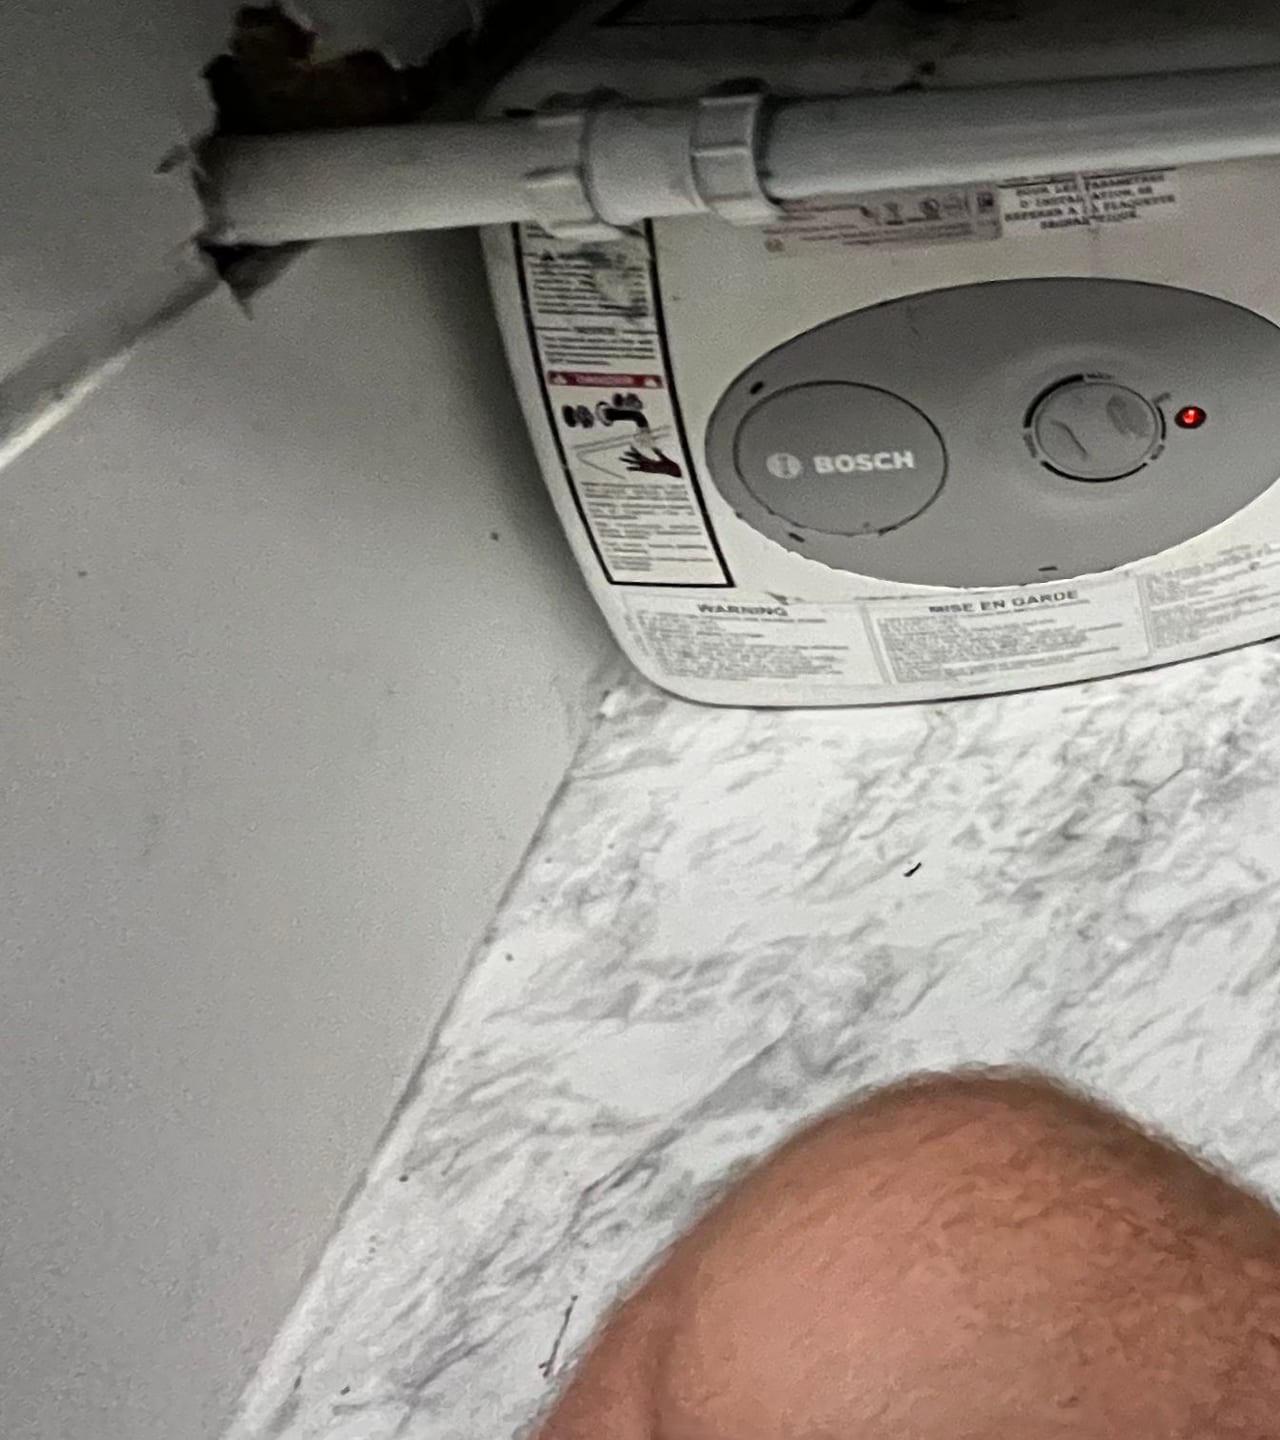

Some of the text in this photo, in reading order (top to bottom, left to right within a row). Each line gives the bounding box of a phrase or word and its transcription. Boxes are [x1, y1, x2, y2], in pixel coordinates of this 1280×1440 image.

[812, 449, 917, 475] BOSCH
[697, 603, 789, 617] WARNING
[980, 599, 1006, 611] EN
[1012, 589, 1079, 607] GARDE
